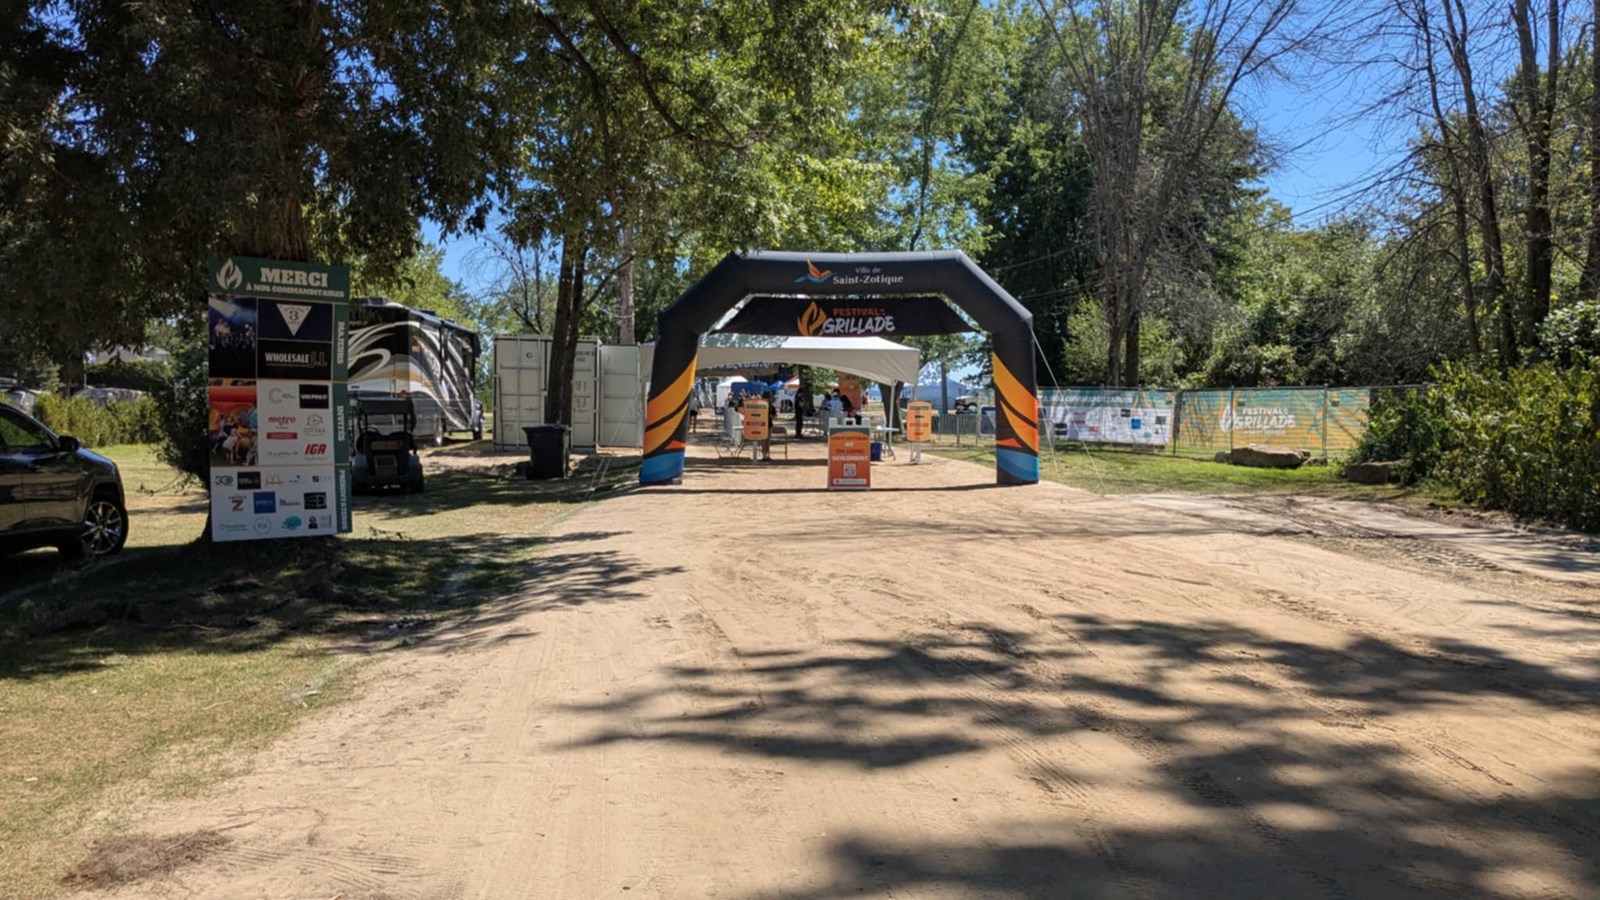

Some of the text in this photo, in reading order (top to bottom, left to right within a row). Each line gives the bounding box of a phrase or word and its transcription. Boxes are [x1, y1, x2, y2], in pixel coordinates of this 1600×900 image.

[855, 266, 881, 274] Ville de
[260, 267, 329, 287] MERCI
[832, 275, 904, 285] Saint-Zotique
[253, 284, 271, 293] NOS
[272, 286, 344, 298] COMMANDITAIRES
[833, 307, 880, 316] FESTIVAL
[822, 315, 896, 335] GRILLADE
[336, 321, 346, 365] MAJEURS
[265, 352, 310, 363] WHOLESALE
[1242, 407, 1283, 416] FESTIVAL
[268, 416, 297, 424] metro
[1232, 414, 1297, 430] GRILLADE
[304, 443, 327, 456] IGA
